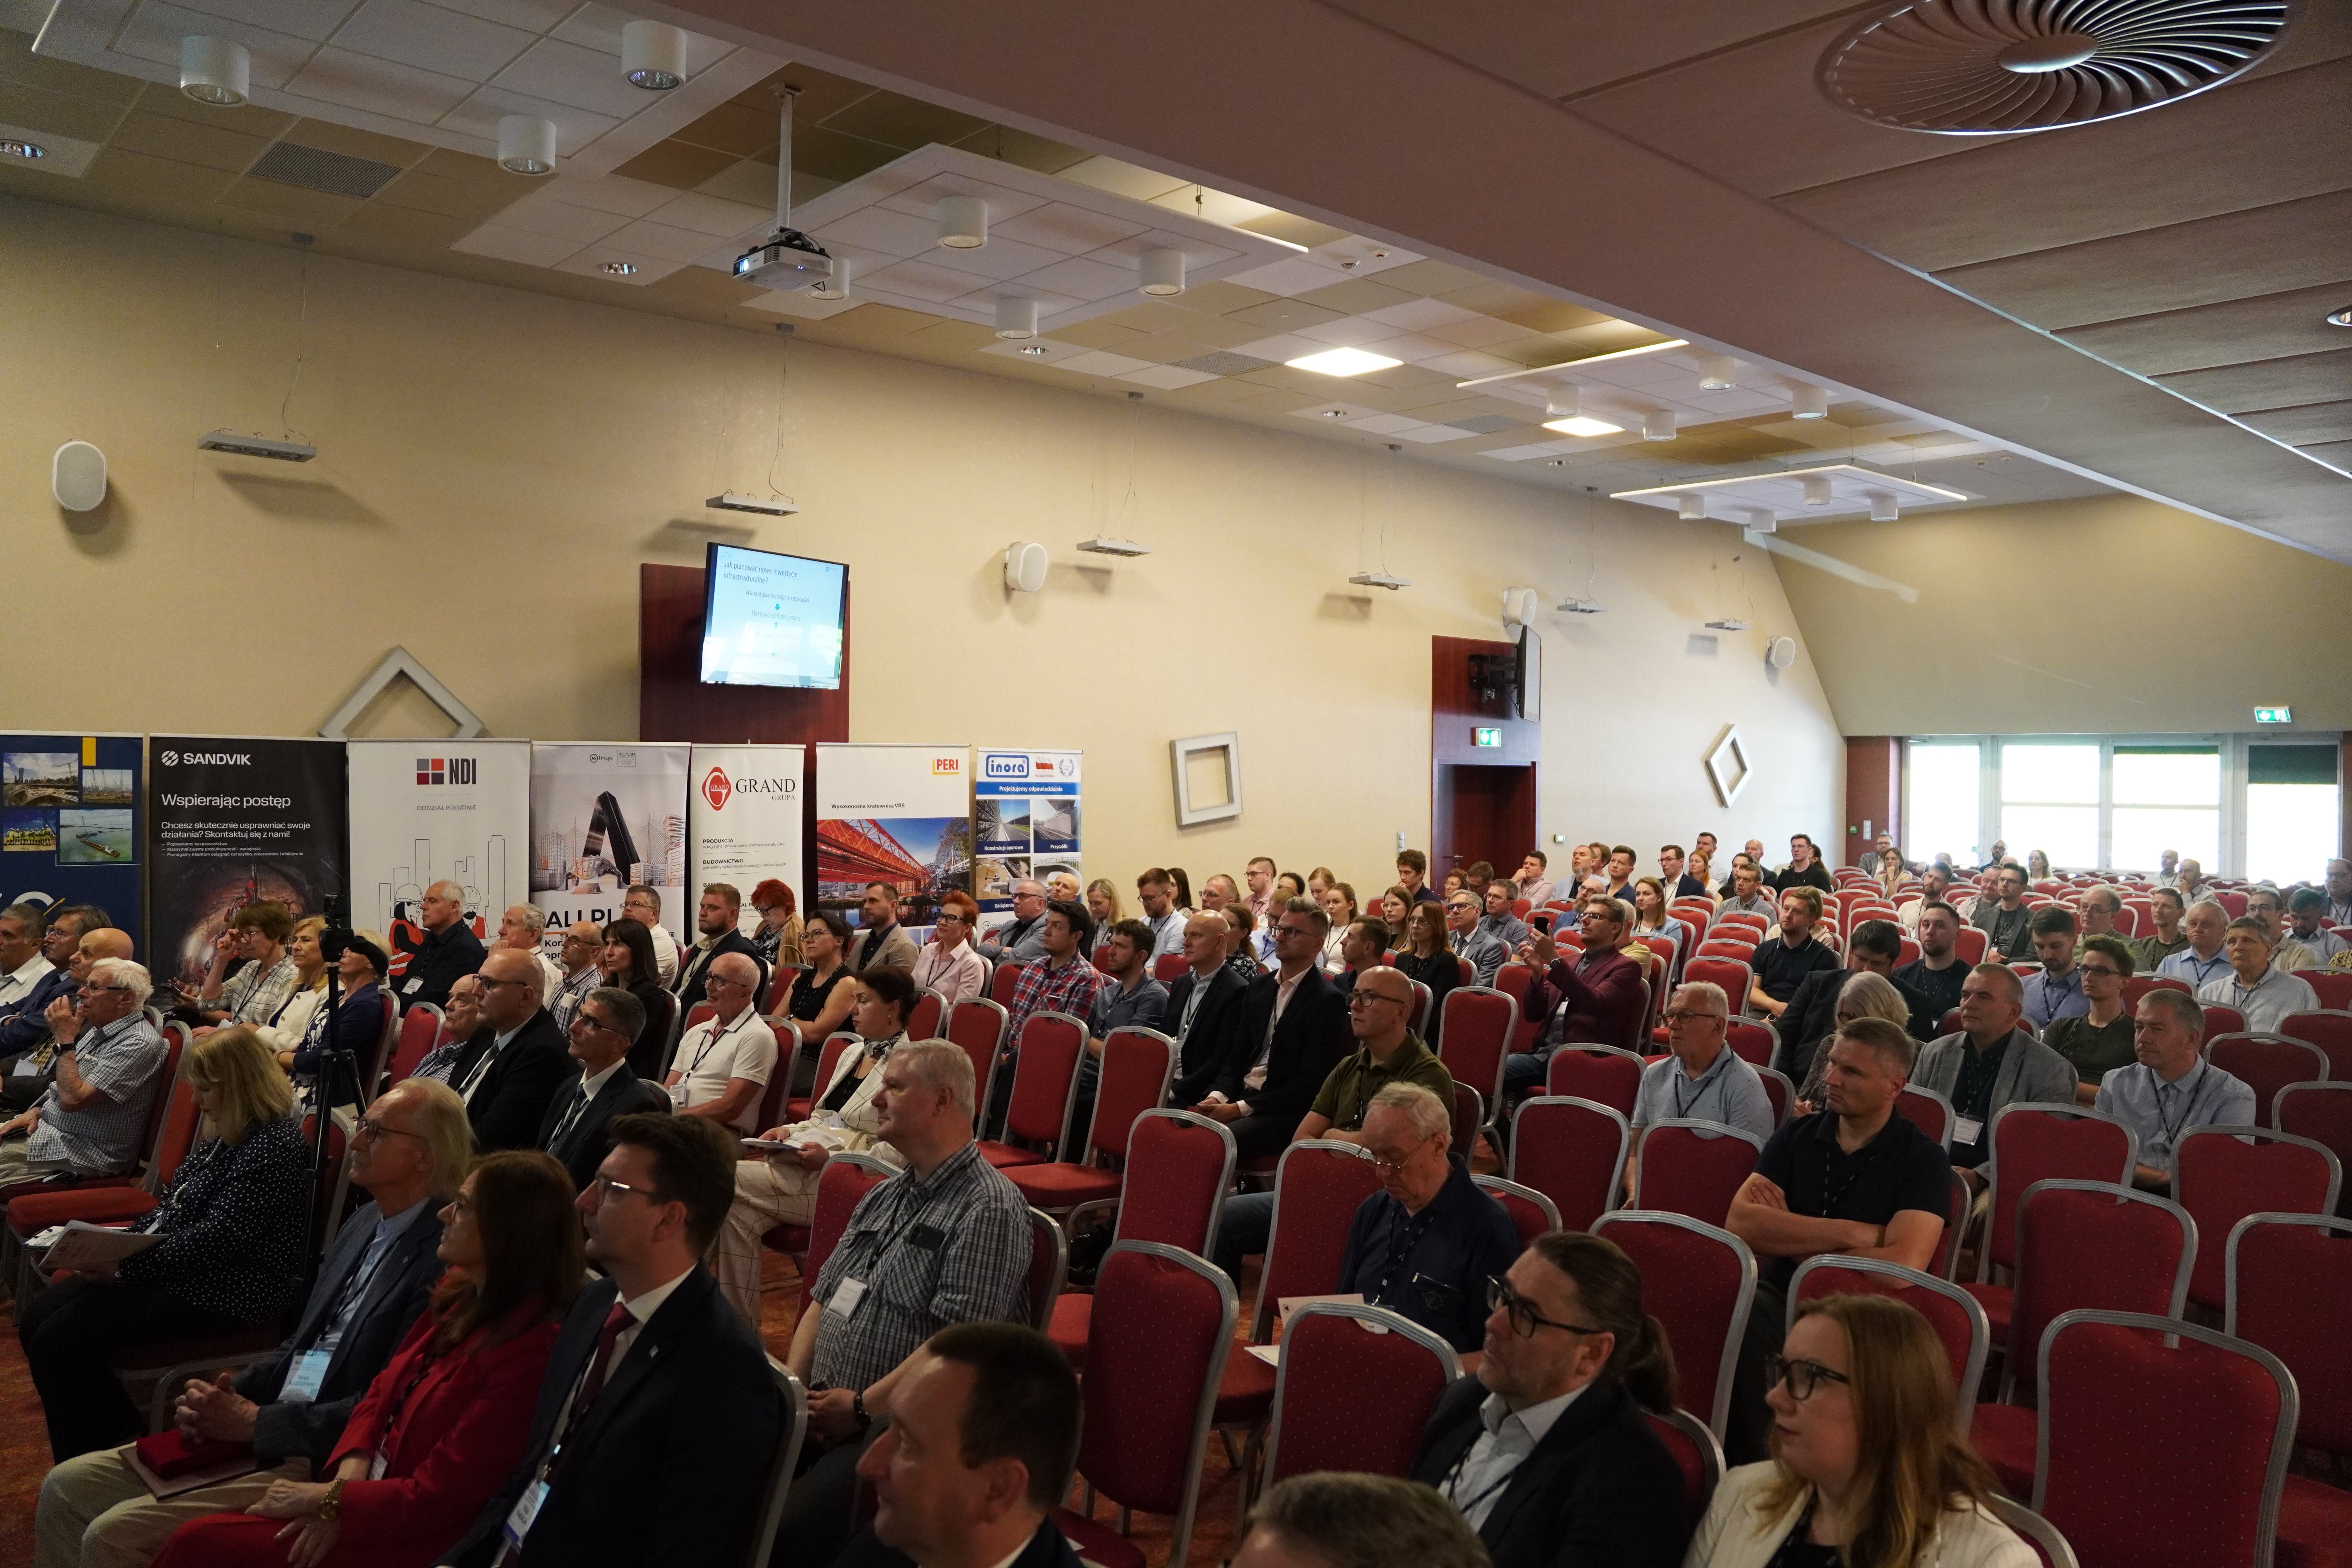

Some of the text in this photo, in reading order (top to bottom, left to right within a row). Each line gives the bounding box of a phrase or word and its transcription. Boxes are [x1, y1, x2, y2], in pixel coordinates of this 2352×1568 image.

[734, 562, 757, 572] planować
[773, 568, 798, 579] inwestycje
[724, 572, 768, 584] infrastrukturalne?
[746, 590, 770, 598] Wariantowe
[771, 592, 790, 601] koncepcje
[751, 610, 801, 621] Efektywność funkcjonalna
[183, 753, 251, 765] SANDVIK
[936, 759, 958, 770] PERI
[449, 758, 476, 784] NDI
[991, 760, 1025, 773] inora
[735, 779, 795, 793] GRAND
[162, 794, 291, 808] Wspierając postęp
[240, 822, 285, 830] usprawniać
[287, 822, 310, 830] swoje
[205, 831, 248, 839] Skontaktuj
